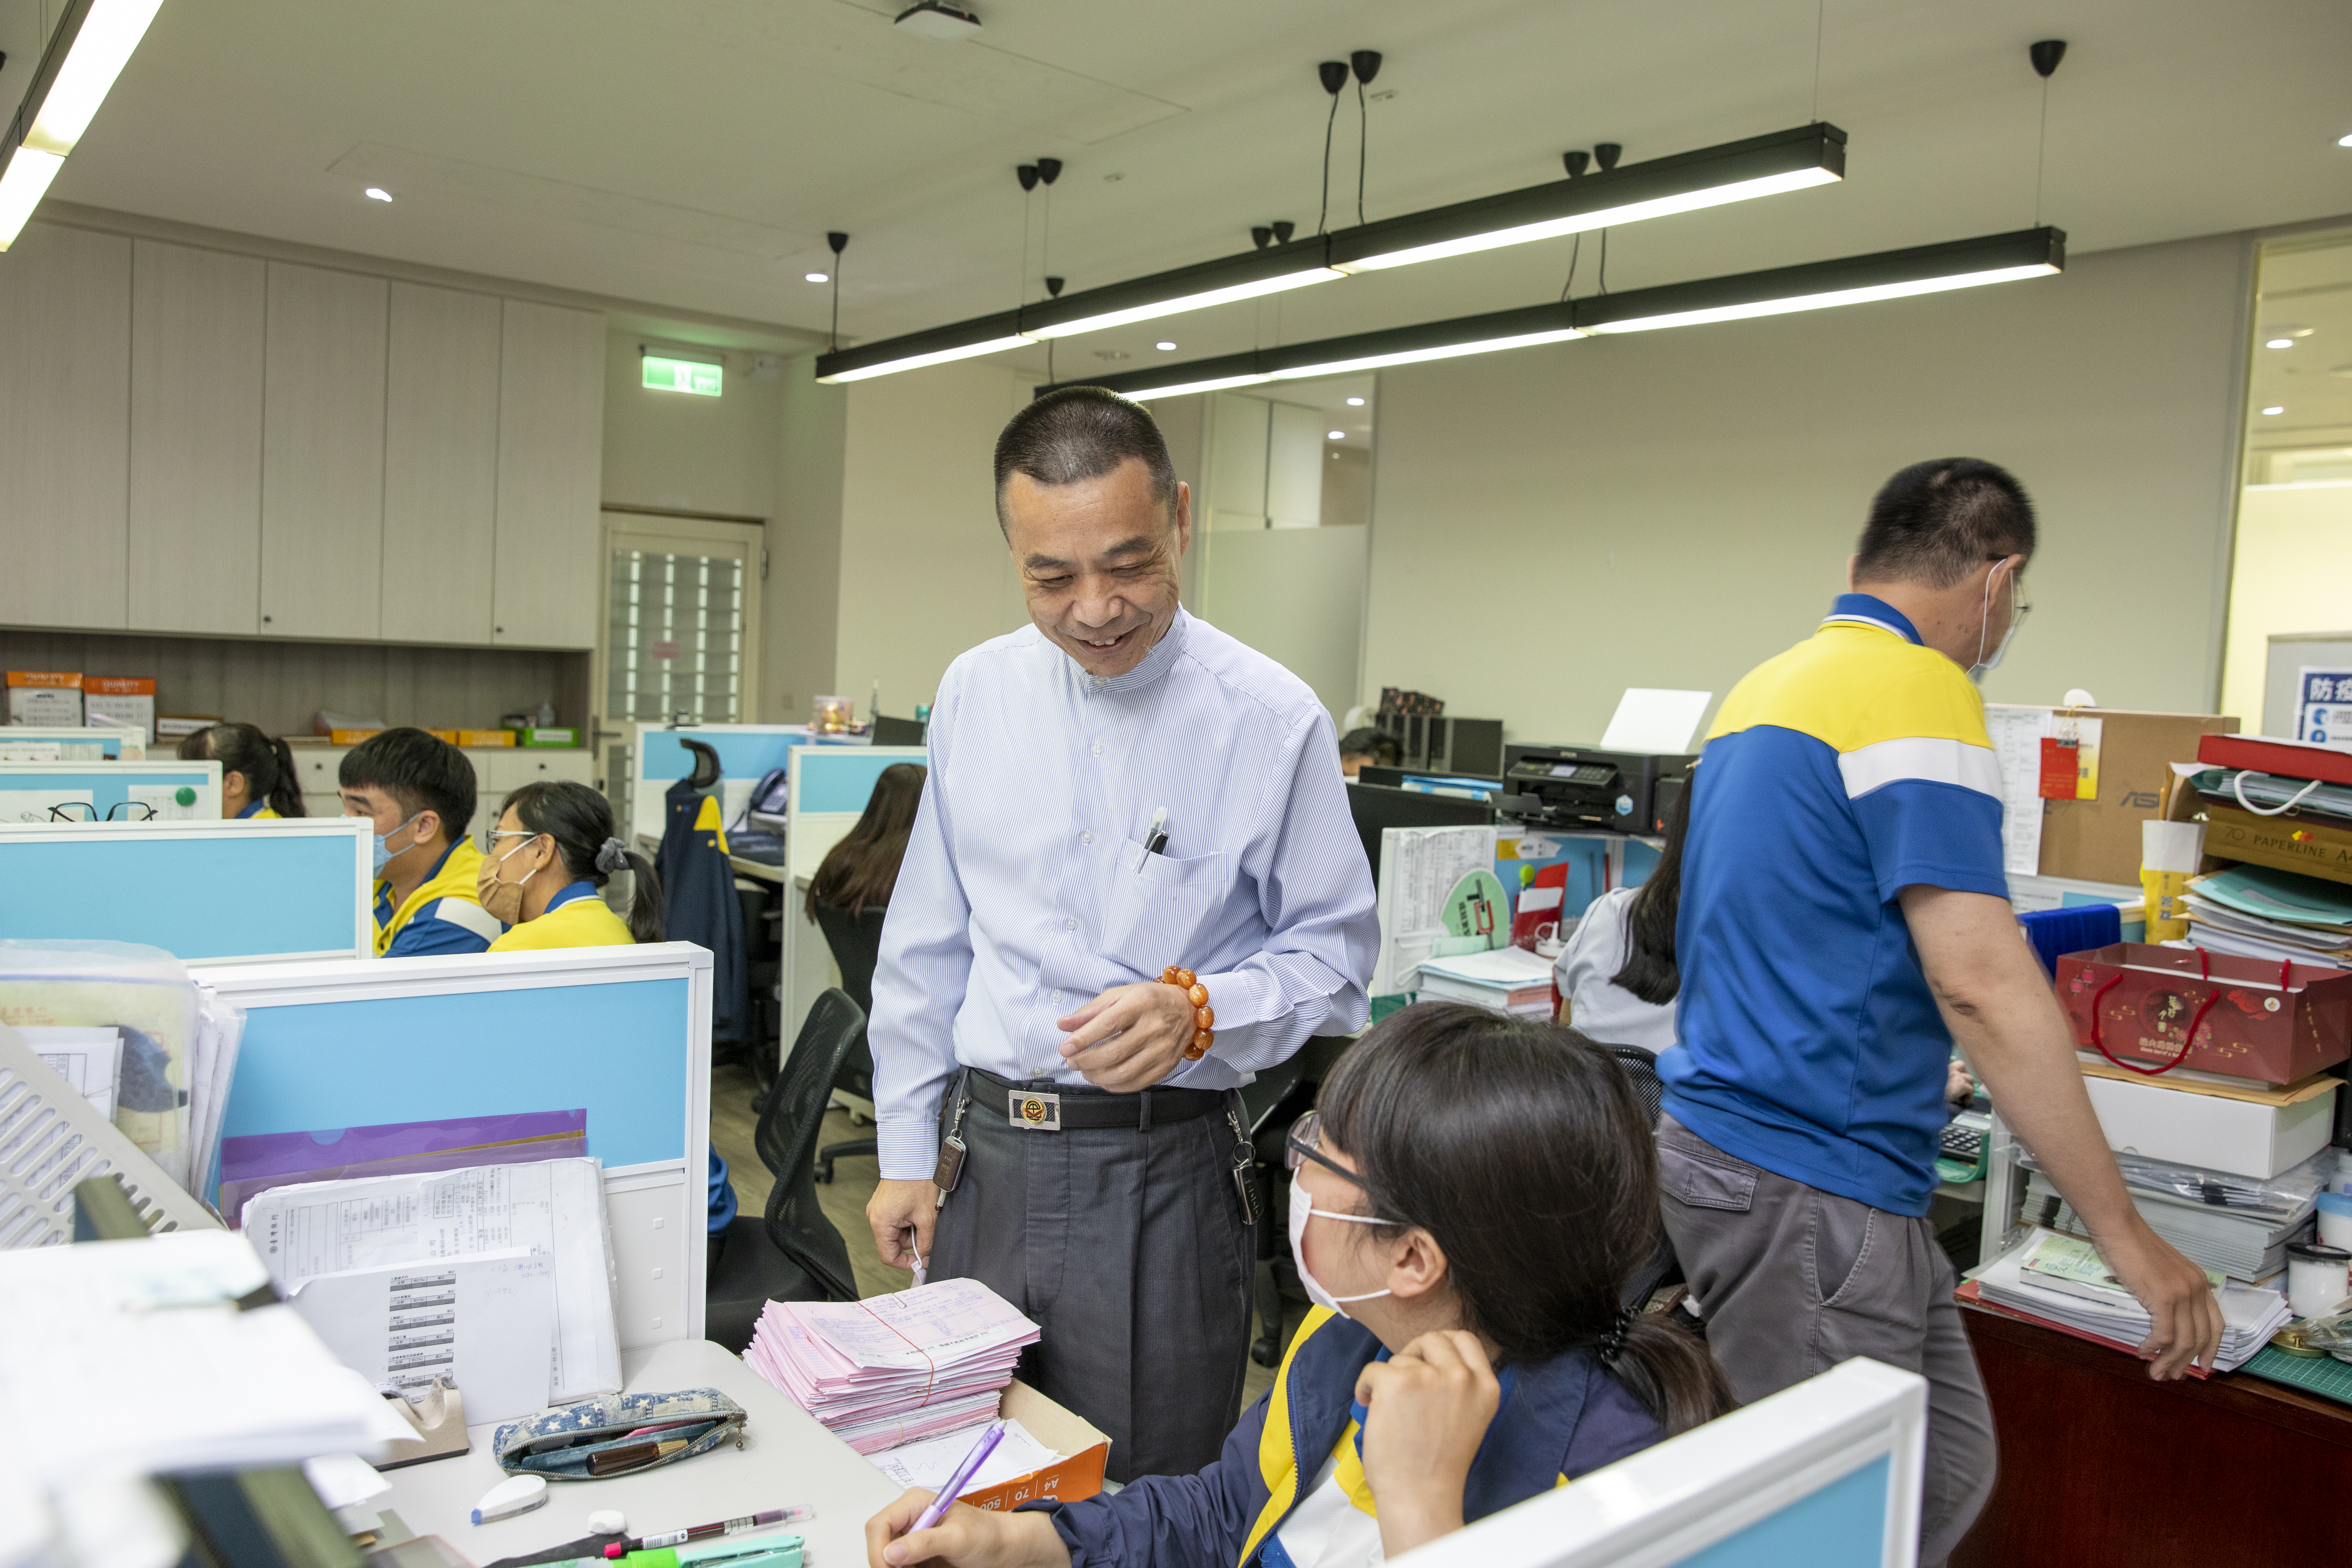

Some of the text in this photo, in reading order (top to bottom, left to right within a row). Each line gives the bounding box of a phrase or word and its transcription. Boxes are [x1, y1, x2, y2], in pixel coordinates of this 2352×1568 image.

[2253, 835, 2326, 858] PAPERLINE
[1044, 1478, 1059, 1492] A4
[1015, 1488, 1029, 1501] 70
[979, 1498, 1002, 1511] 500
